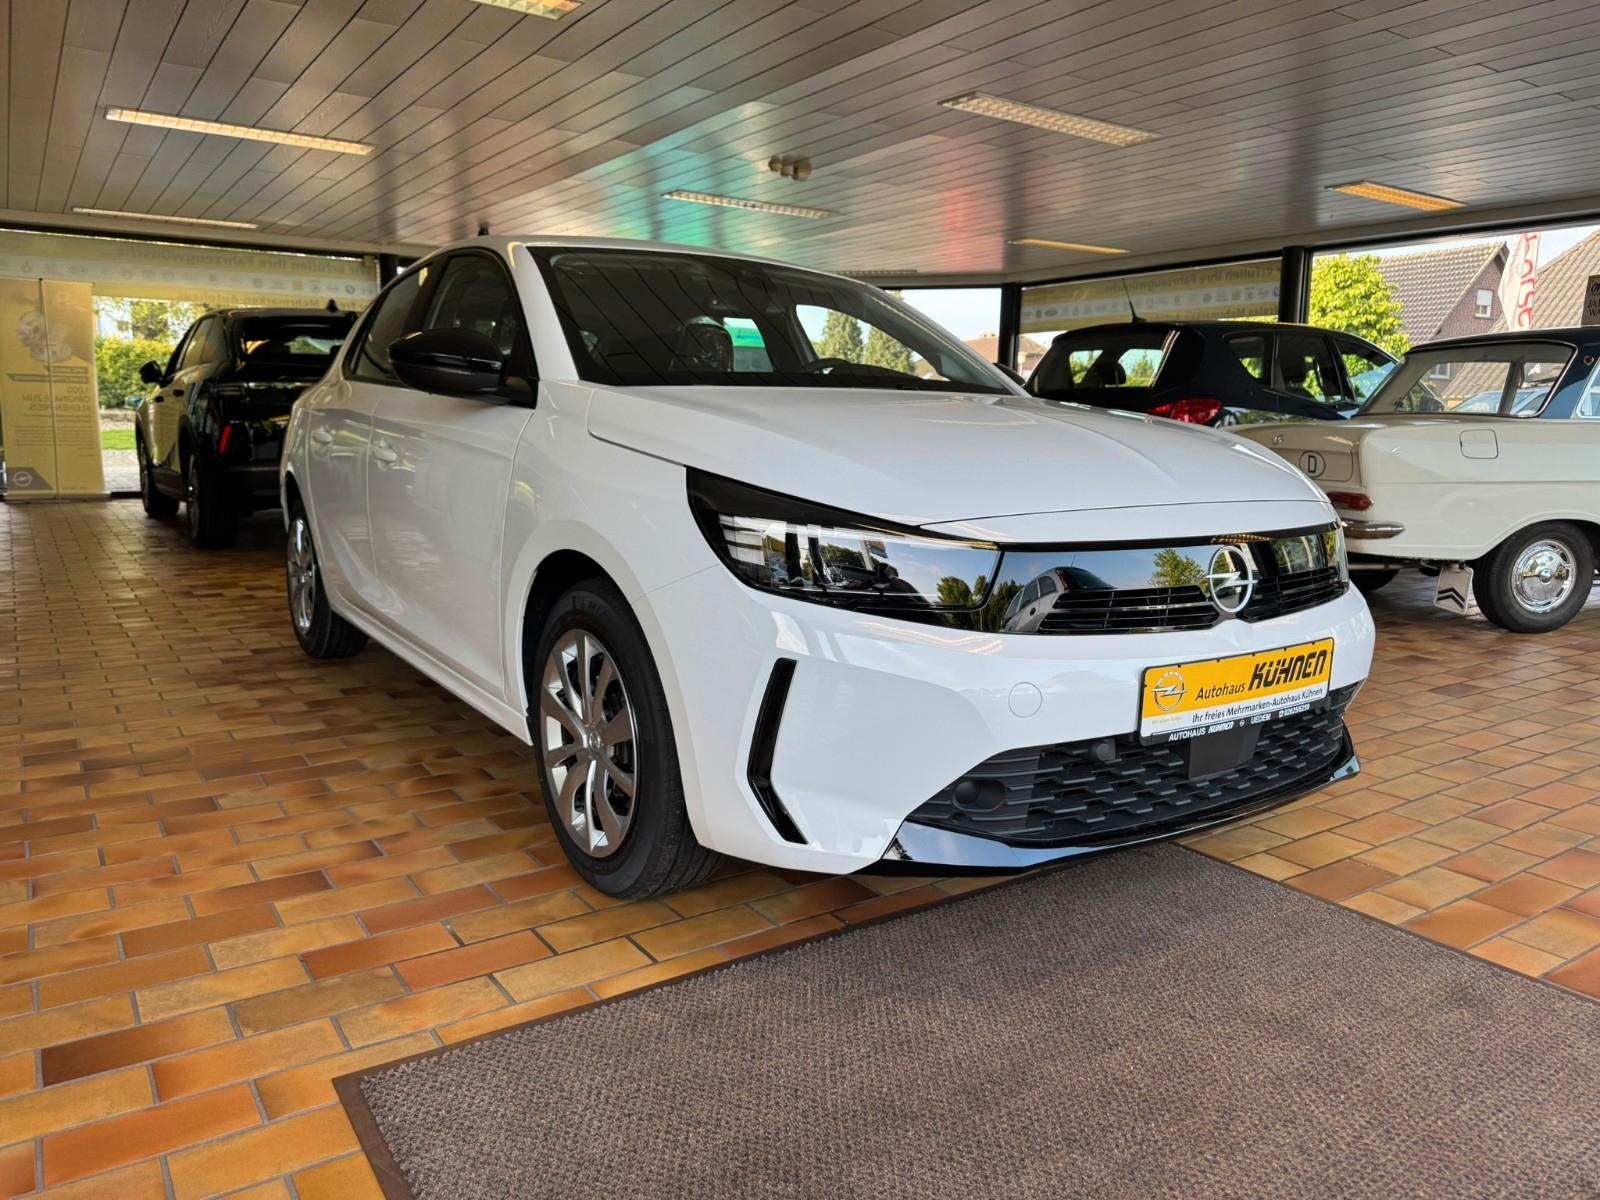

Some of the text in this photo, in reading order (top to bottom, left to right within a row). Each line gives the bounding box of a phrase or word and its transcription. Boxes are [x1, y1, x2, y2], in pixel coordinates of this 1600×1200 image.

[1307, 455, 1317, 473] D
[1195, 682, 1245, 701] Autohaus
[1191, 711, 1204, 724] Ihr
[1205, 708, 1225, 723] freies
[1226, 693, 1301, 718] Mehrmarken-Autohaus
[1301, 687, 1323, 700] Kühnen
[1168, 727, 1206, 742] AUTOHAUS
